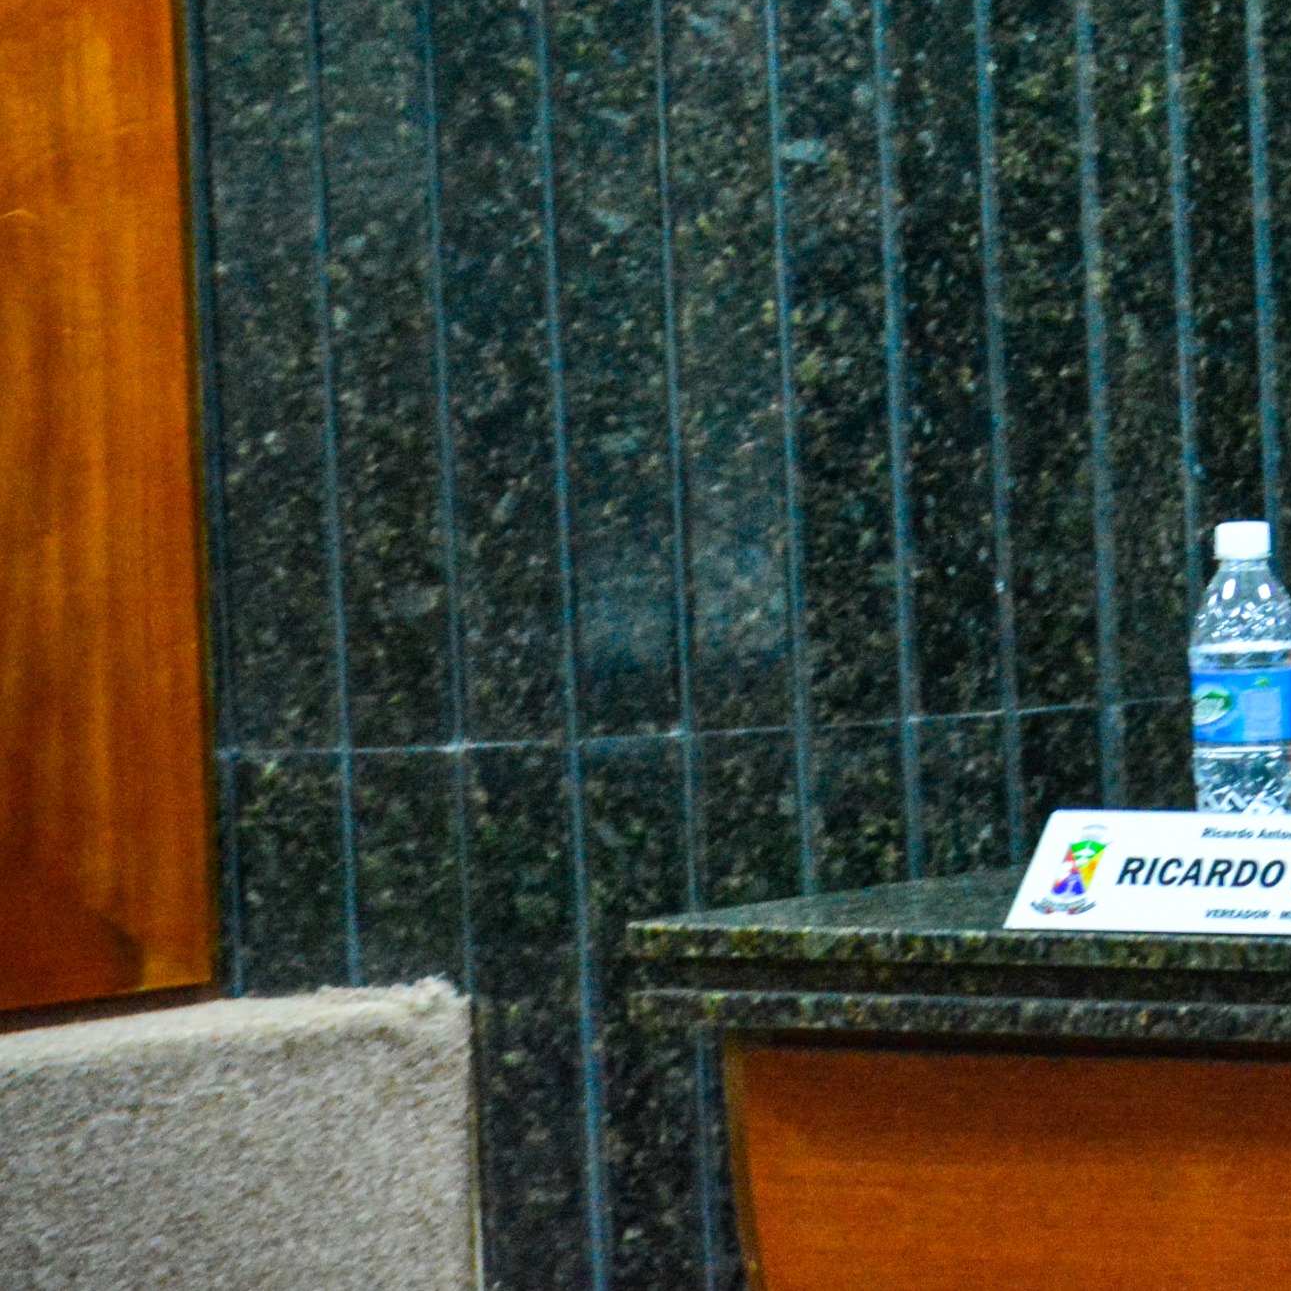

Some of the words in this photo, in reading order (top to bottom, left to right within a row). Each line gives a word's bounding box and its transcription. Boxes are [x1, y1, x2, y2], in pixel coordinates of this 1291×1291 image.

[1201, 826, 1255, 840] Ricardo
[1116, 856, 1286, 888] RICARDO
[1205, 909, 1271, 920] VEREADOR
